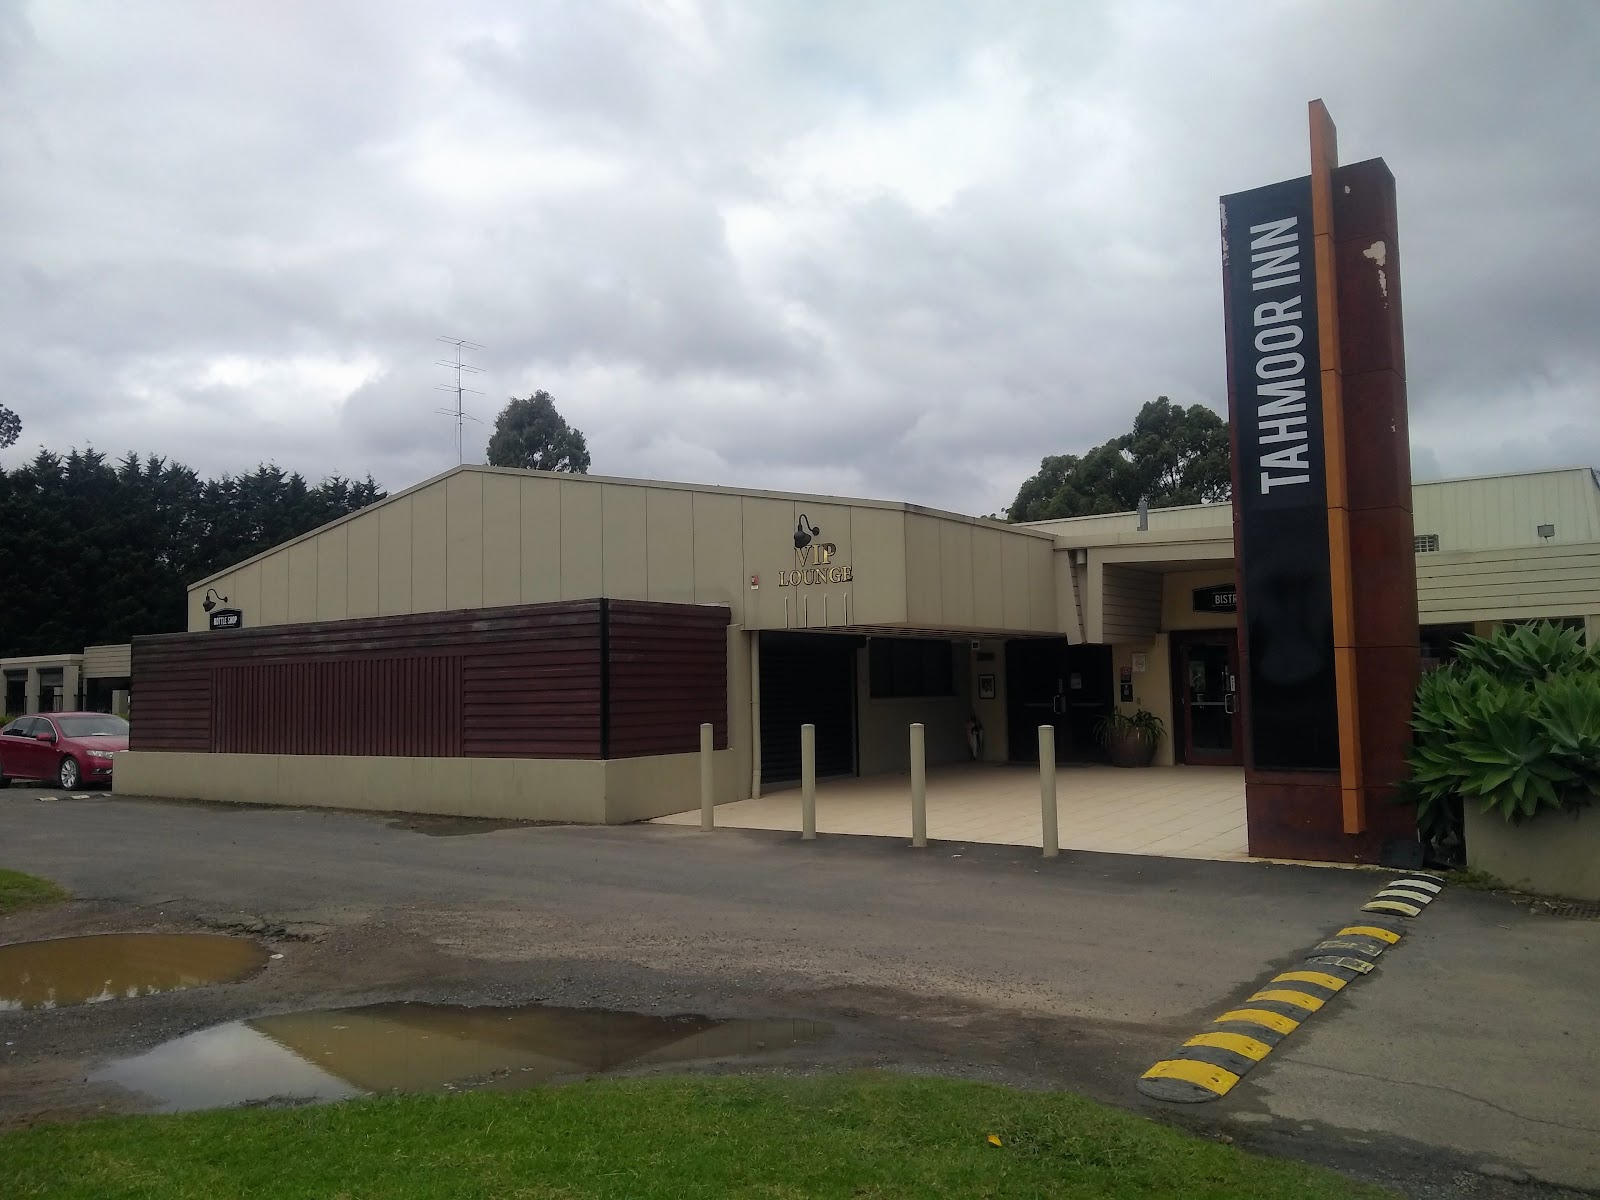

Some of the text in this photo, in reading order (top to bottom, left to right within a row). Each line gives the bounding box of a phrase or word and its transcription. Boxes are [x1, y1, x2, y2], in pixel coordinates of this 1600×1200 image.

[1250, 216, 1310, 495] TAHMOOR INN
[794, 543, 837, 567] VIP
[779, 566, 854, 587] LOUNGE
[213, 615, 238, 626] BOTTLE SHOP
